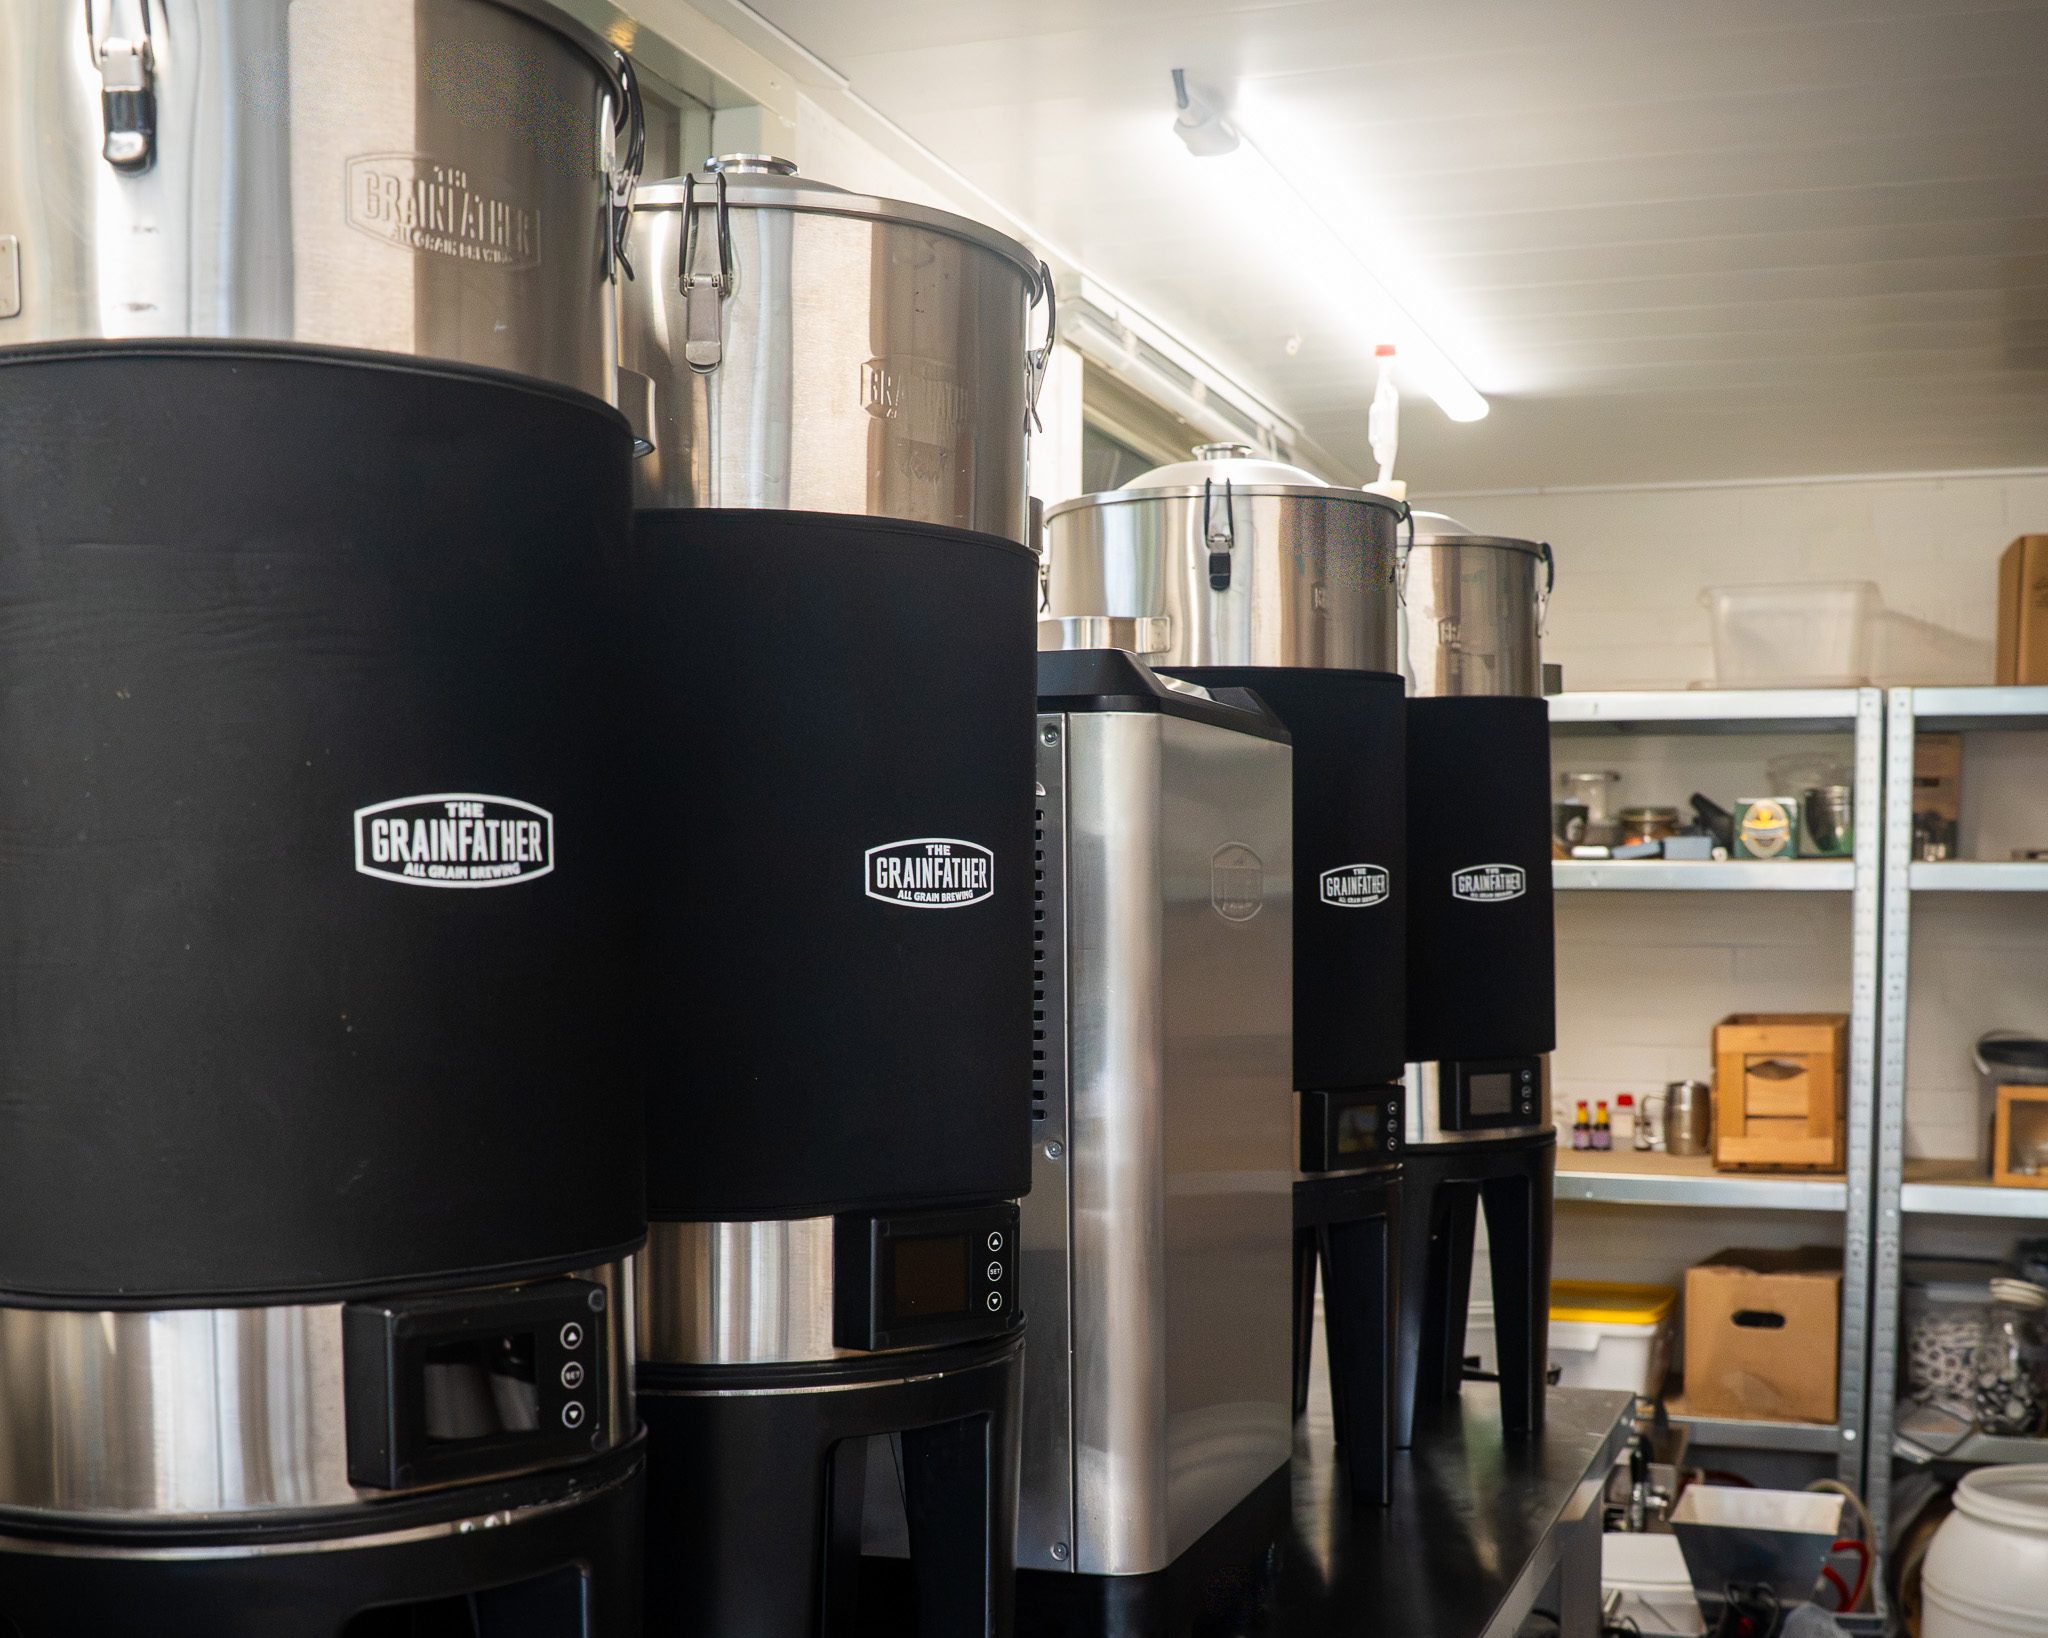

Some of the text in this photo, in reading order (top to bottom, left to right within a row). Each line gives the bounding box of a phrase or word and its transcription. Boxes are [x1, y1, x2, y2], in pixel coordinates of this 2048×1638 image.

[445, 802, 485, 818] THE
[371, 818, 543, 863] GRAINFATHER
[926, 844, 951, 856] THE
[403, 862, 427, 877] ALL
[428, 865, 468, 879] GRAIN
[876, 857, 988, 889] GRAINFATHER
[1327, 874, 1386, 897] GRAINFATHER
[1458, 873, 1521, 893] GRAINFATHER
[898, 889, 974, 903] ALL GRAIN BREWING
